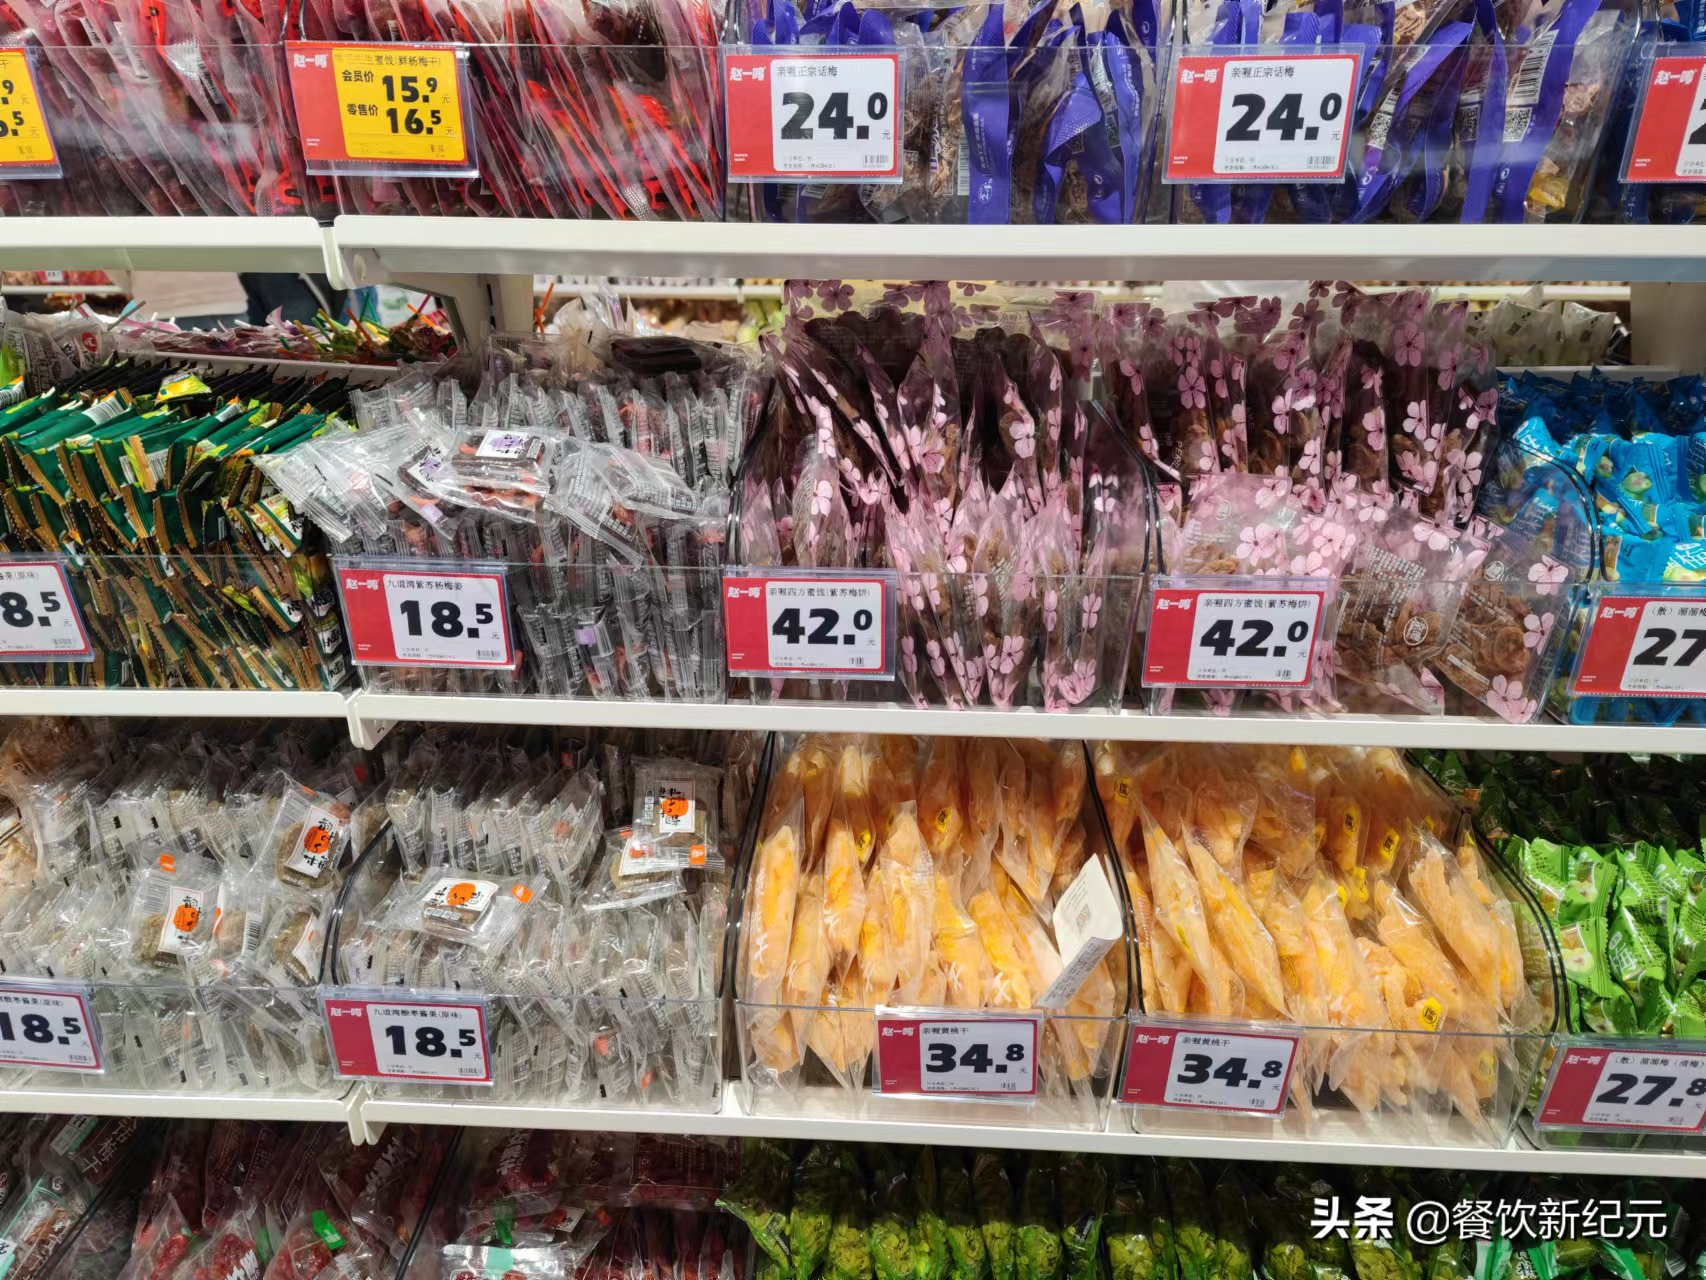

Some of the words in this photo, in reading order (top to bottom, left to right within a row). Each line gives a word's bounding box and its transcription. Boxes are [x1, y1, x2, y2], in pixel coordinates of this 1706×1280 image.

[294, 54, 327, 68] 赵一鸣
[730, 67, 766, 81] 赵一鸣
[1180, 69, 1219, 84] 赵一鸣
[342, 70, 374, 83] 会员价
[382, 75, 437, 103] 15.9
[347, 104, 378, 116] 零售价
[386, 108, 441, 135] 16.5
[781, 92, 888, 140] 24.0
[881, 130, 892, 140] 元
[1225, 92, 1343, 141] 24.0
[1330, 131, 1341, 141] 元
[346, 578, 379, 591] 赵一鸣
[728, 586, 762, 598] 赵一鸣
[1156, 598, 1193, 610] 赵一鸣
[1600, 606, 1640, 618] 赵一鸣
[400, 600, 494, 638] 18.5
[491, 632, 500, 640] 元
[772, 608, 872, 645] 42.0
[1200, 619, 1309, 657] 42.0
[385, 1025, 476, 1058] 18.5
[1136, 1034, 1172, 1045] 赵一鸣
[926, 1043, 1024, 1073] 34.8
[1177, 1053, 1283, 1089] 34.8
[1596, 1073, 1706, 1107] 27.8
